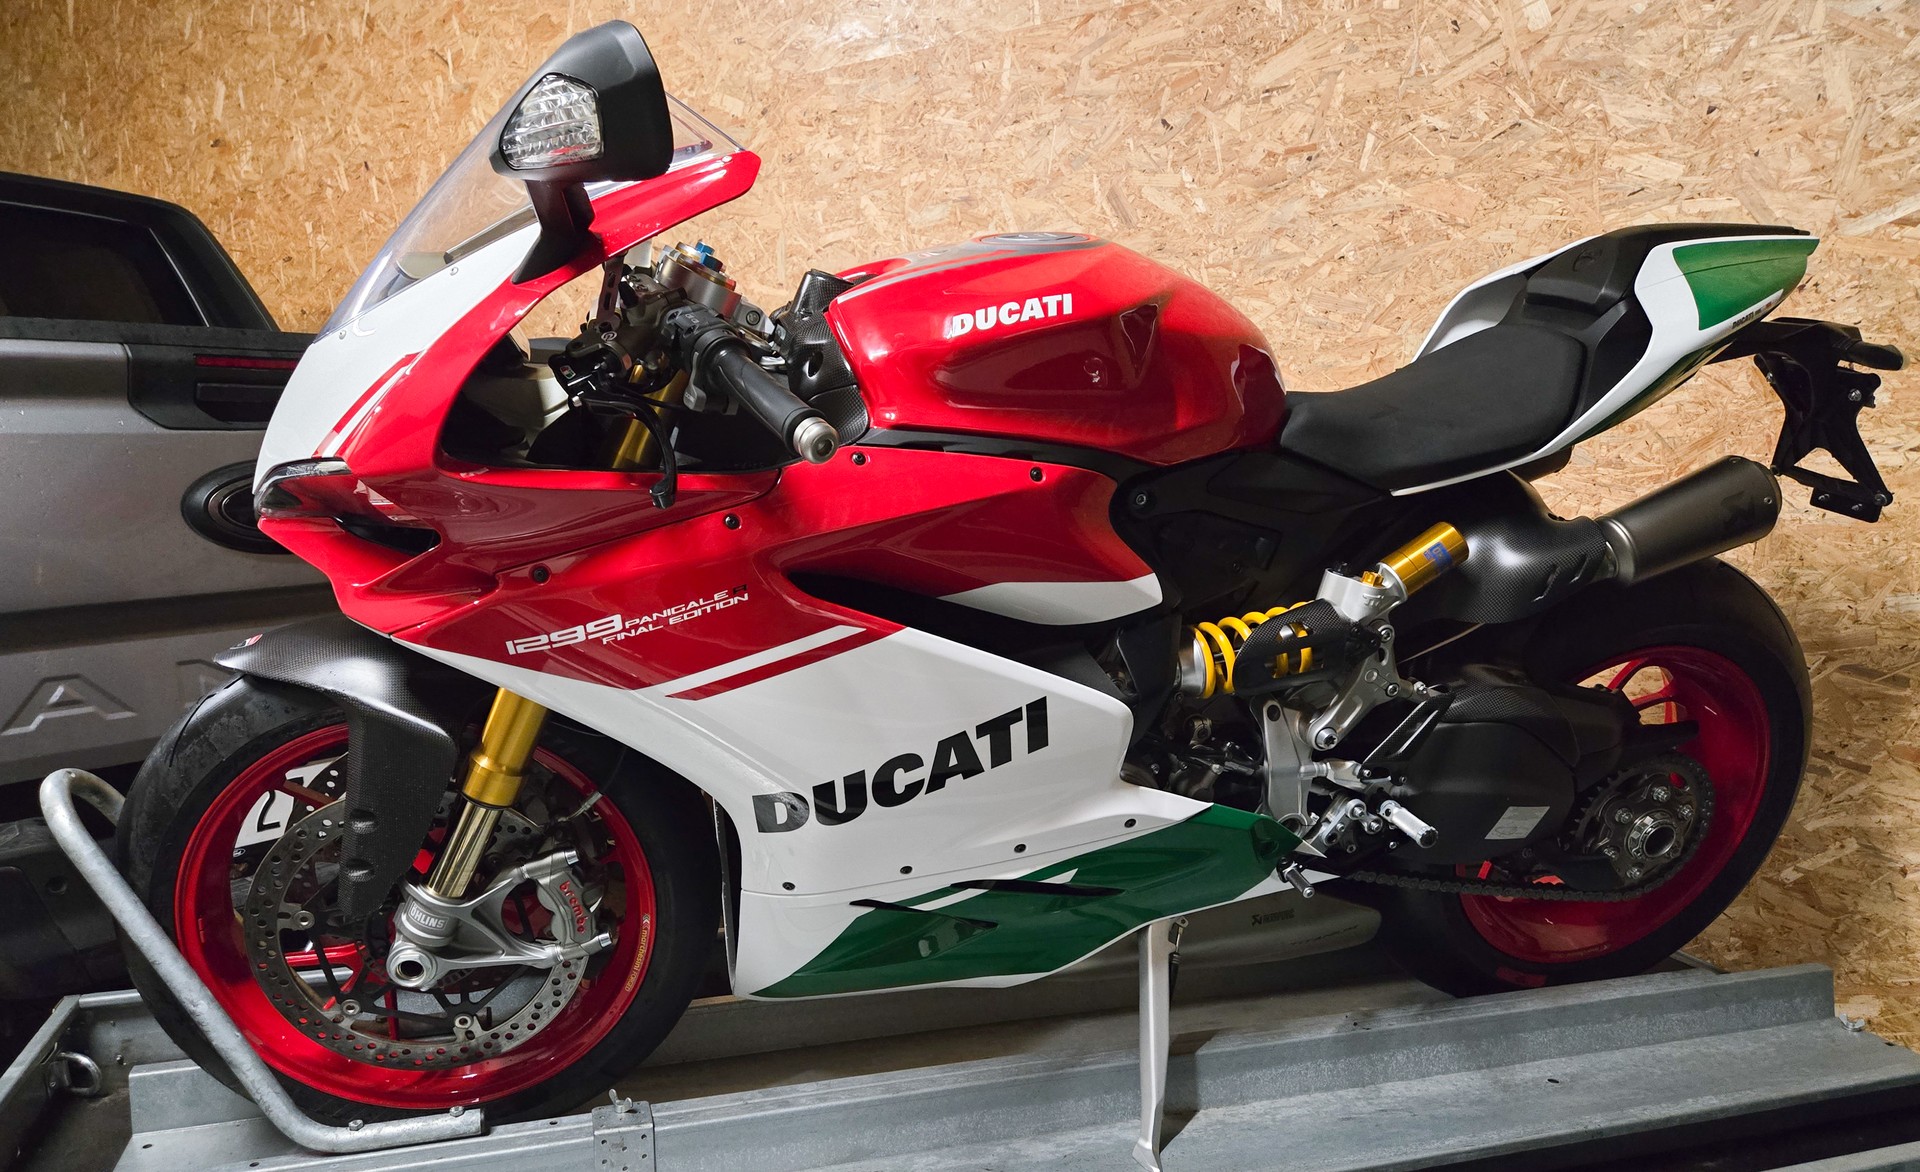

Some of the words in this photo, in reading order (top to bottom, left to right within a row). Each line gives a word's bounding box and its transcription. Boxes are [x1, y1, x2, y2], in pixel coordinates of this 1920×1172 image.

[947, 293, 1073, 339] DUCATI
[505, 613, 624, 655] 1299
[624, 589, 729, 629] PANIGALE
[602, 624, 664, 645] FINAL
[668, 592, 750, 625] EDITION
[752, 695, 1049, 833] DUCATI
[560, 880, 588, 936] brembo
